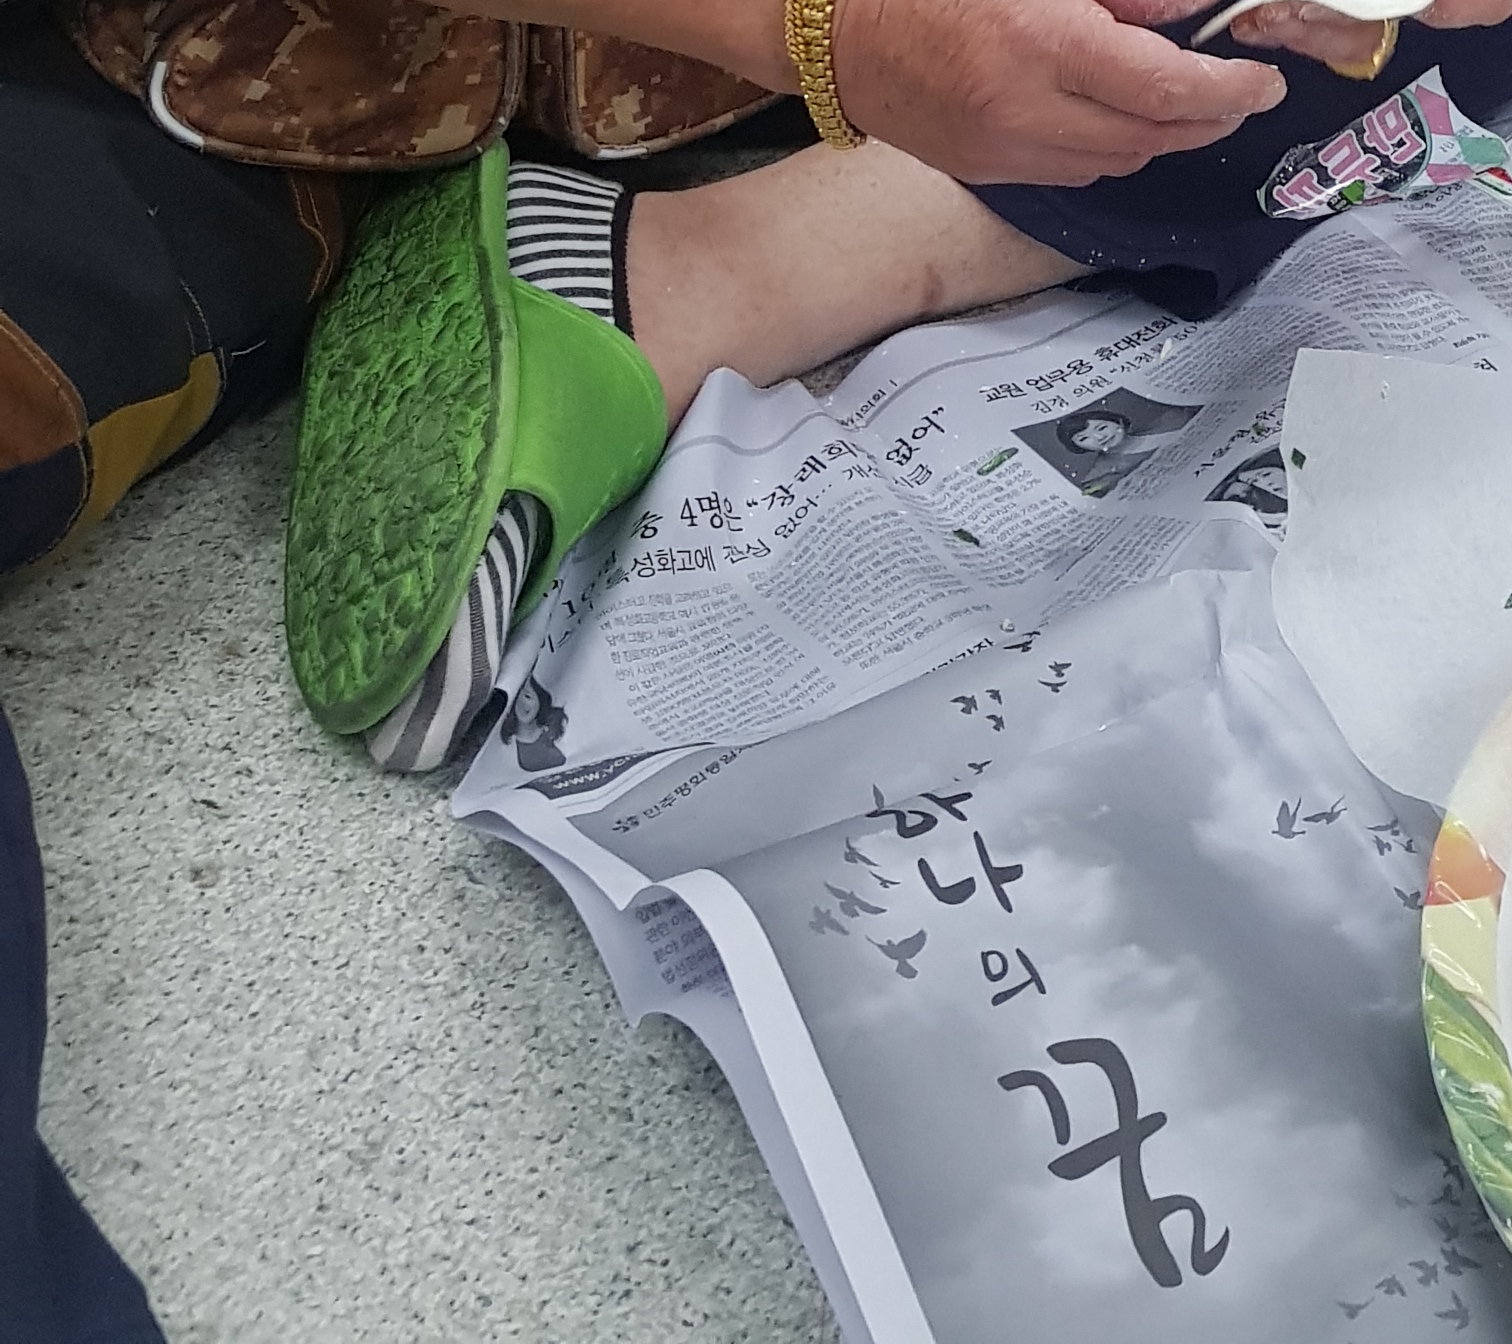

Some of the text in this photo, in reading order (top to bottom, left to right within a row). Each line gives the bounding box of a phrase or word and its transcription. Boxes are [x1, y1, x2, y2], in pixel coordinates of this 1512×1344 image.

[979, 382, 1028, 403] 교원
[1025, 358, 1094, 392] 업무용
[1093, 315, 1179, 362] 휴대전화
[1073, 374, 1113, 398] 의원
[680, 491, 744, 532] 4명은
[723, 538, 771, 564] 관심
[997, 1036, 1230, 1288] 꿈
